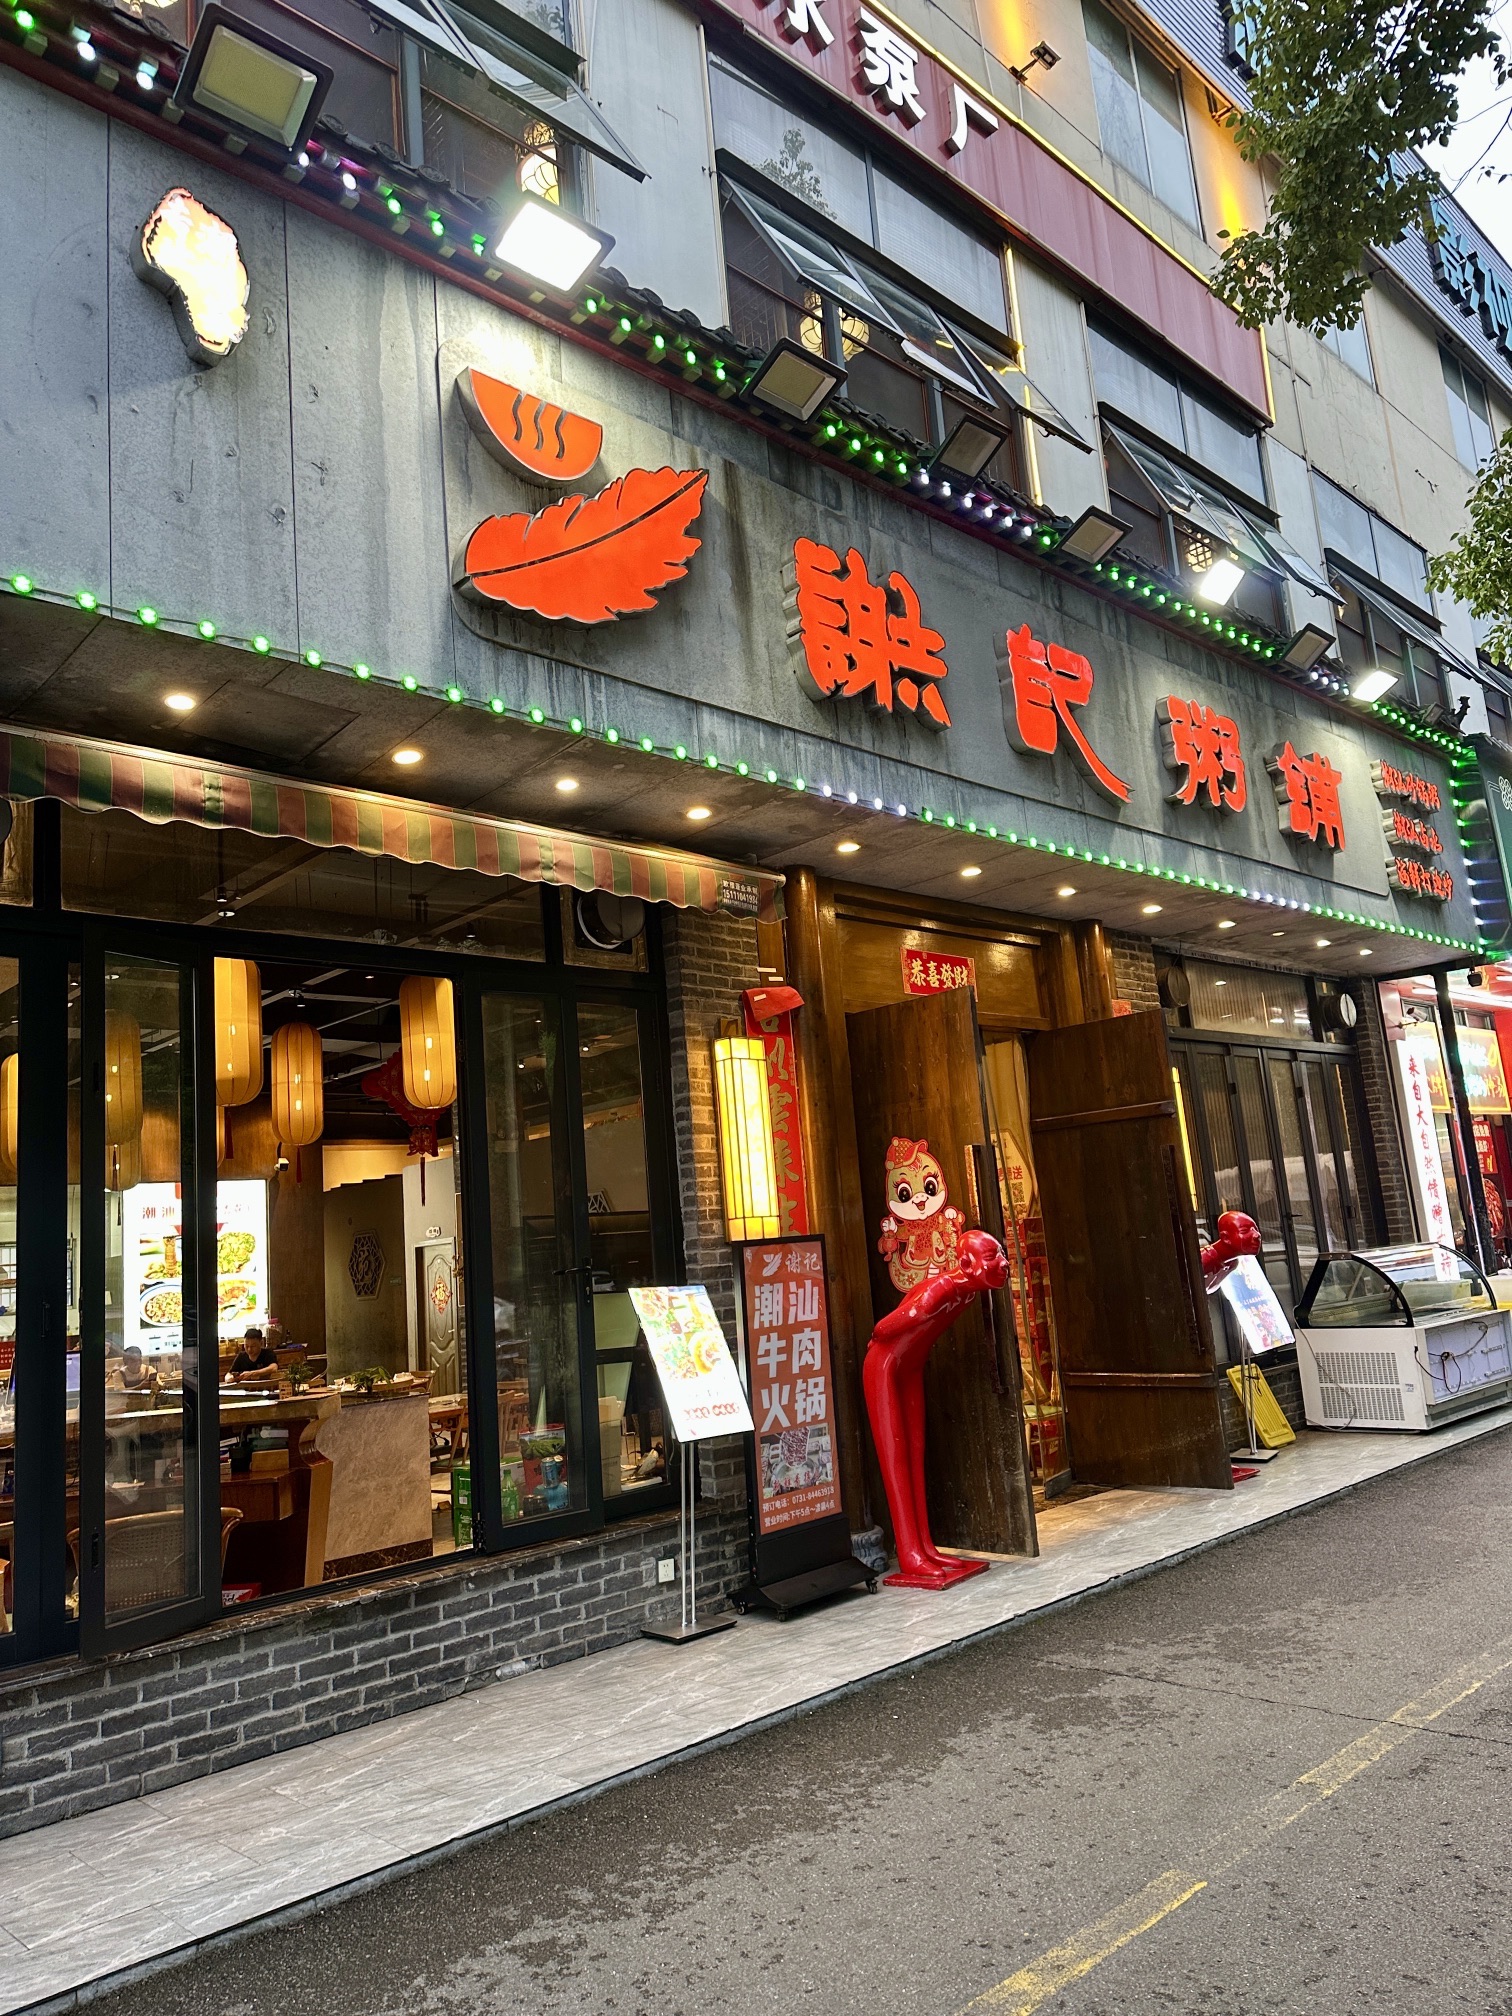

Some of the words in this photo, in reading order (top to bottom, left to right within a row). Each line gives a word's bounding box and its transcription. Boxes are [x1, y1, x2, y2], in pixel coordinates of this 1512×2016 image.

[910, 957, 969, 990] 恭喜發財
[785, 1251, 820, 1273] 谢记
[754, 1280, 819, 1329] 潮汕
[757, 1328, 822, 1378] 牛肉
[760, 1376, 827, 1433] 火锅
